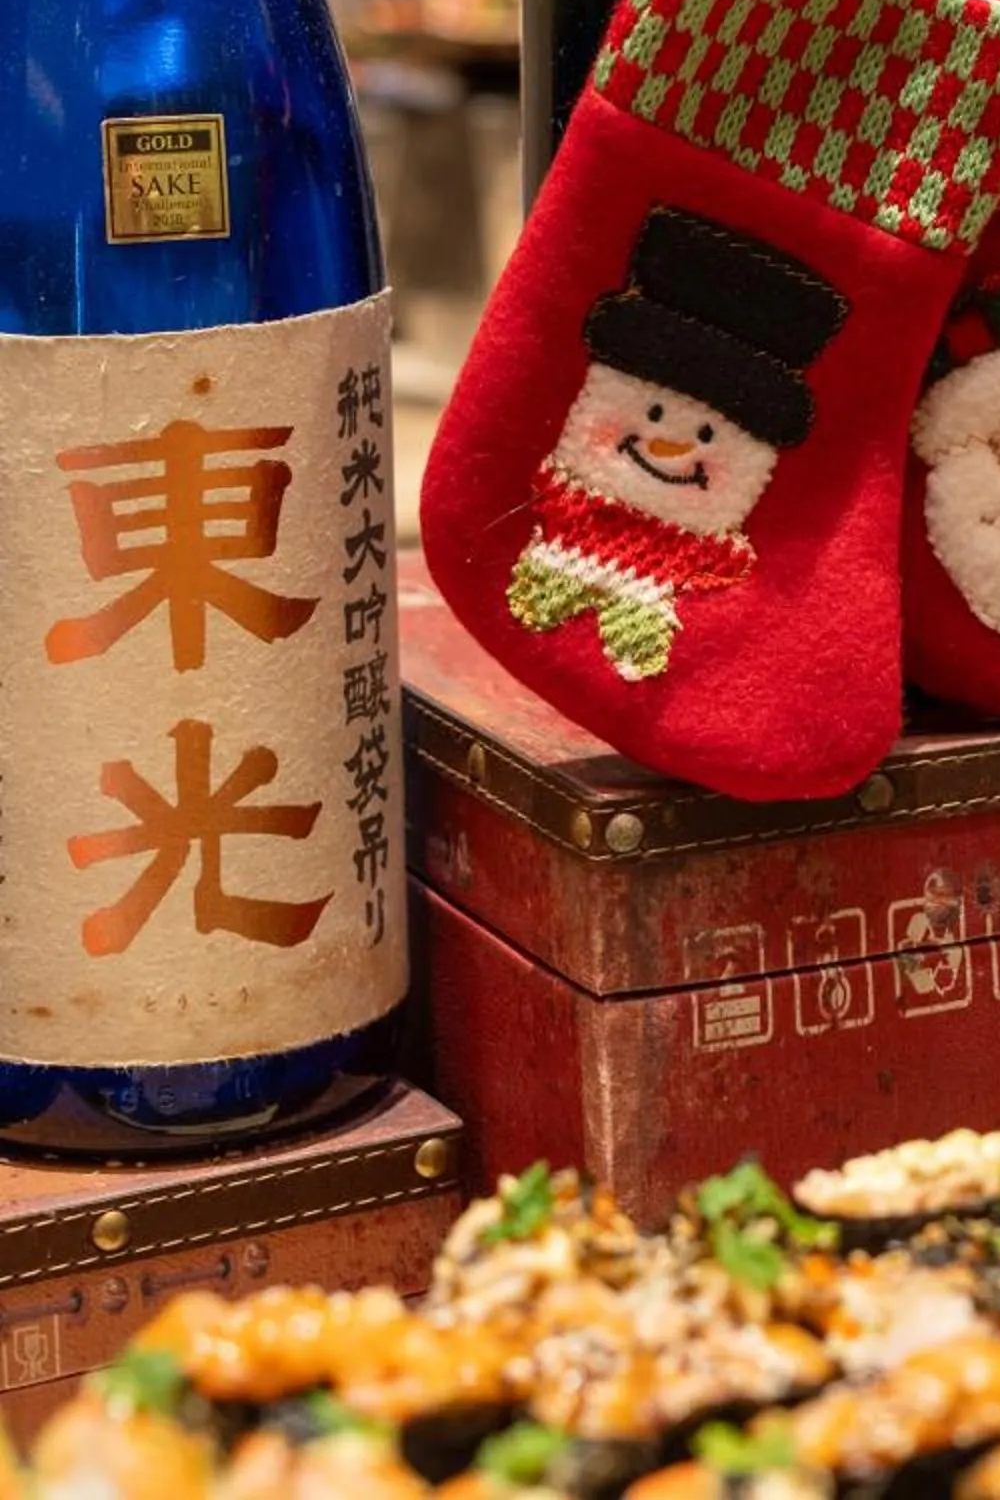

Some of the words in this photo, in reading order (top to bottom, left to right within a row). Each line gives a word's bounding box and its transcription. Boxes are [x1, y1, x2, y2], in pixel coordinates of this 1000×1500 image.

[135, 133, 193, 152] GOLD
[130, 173, 201, 199] SAKE
[44, 419, 334, 958] 東光
